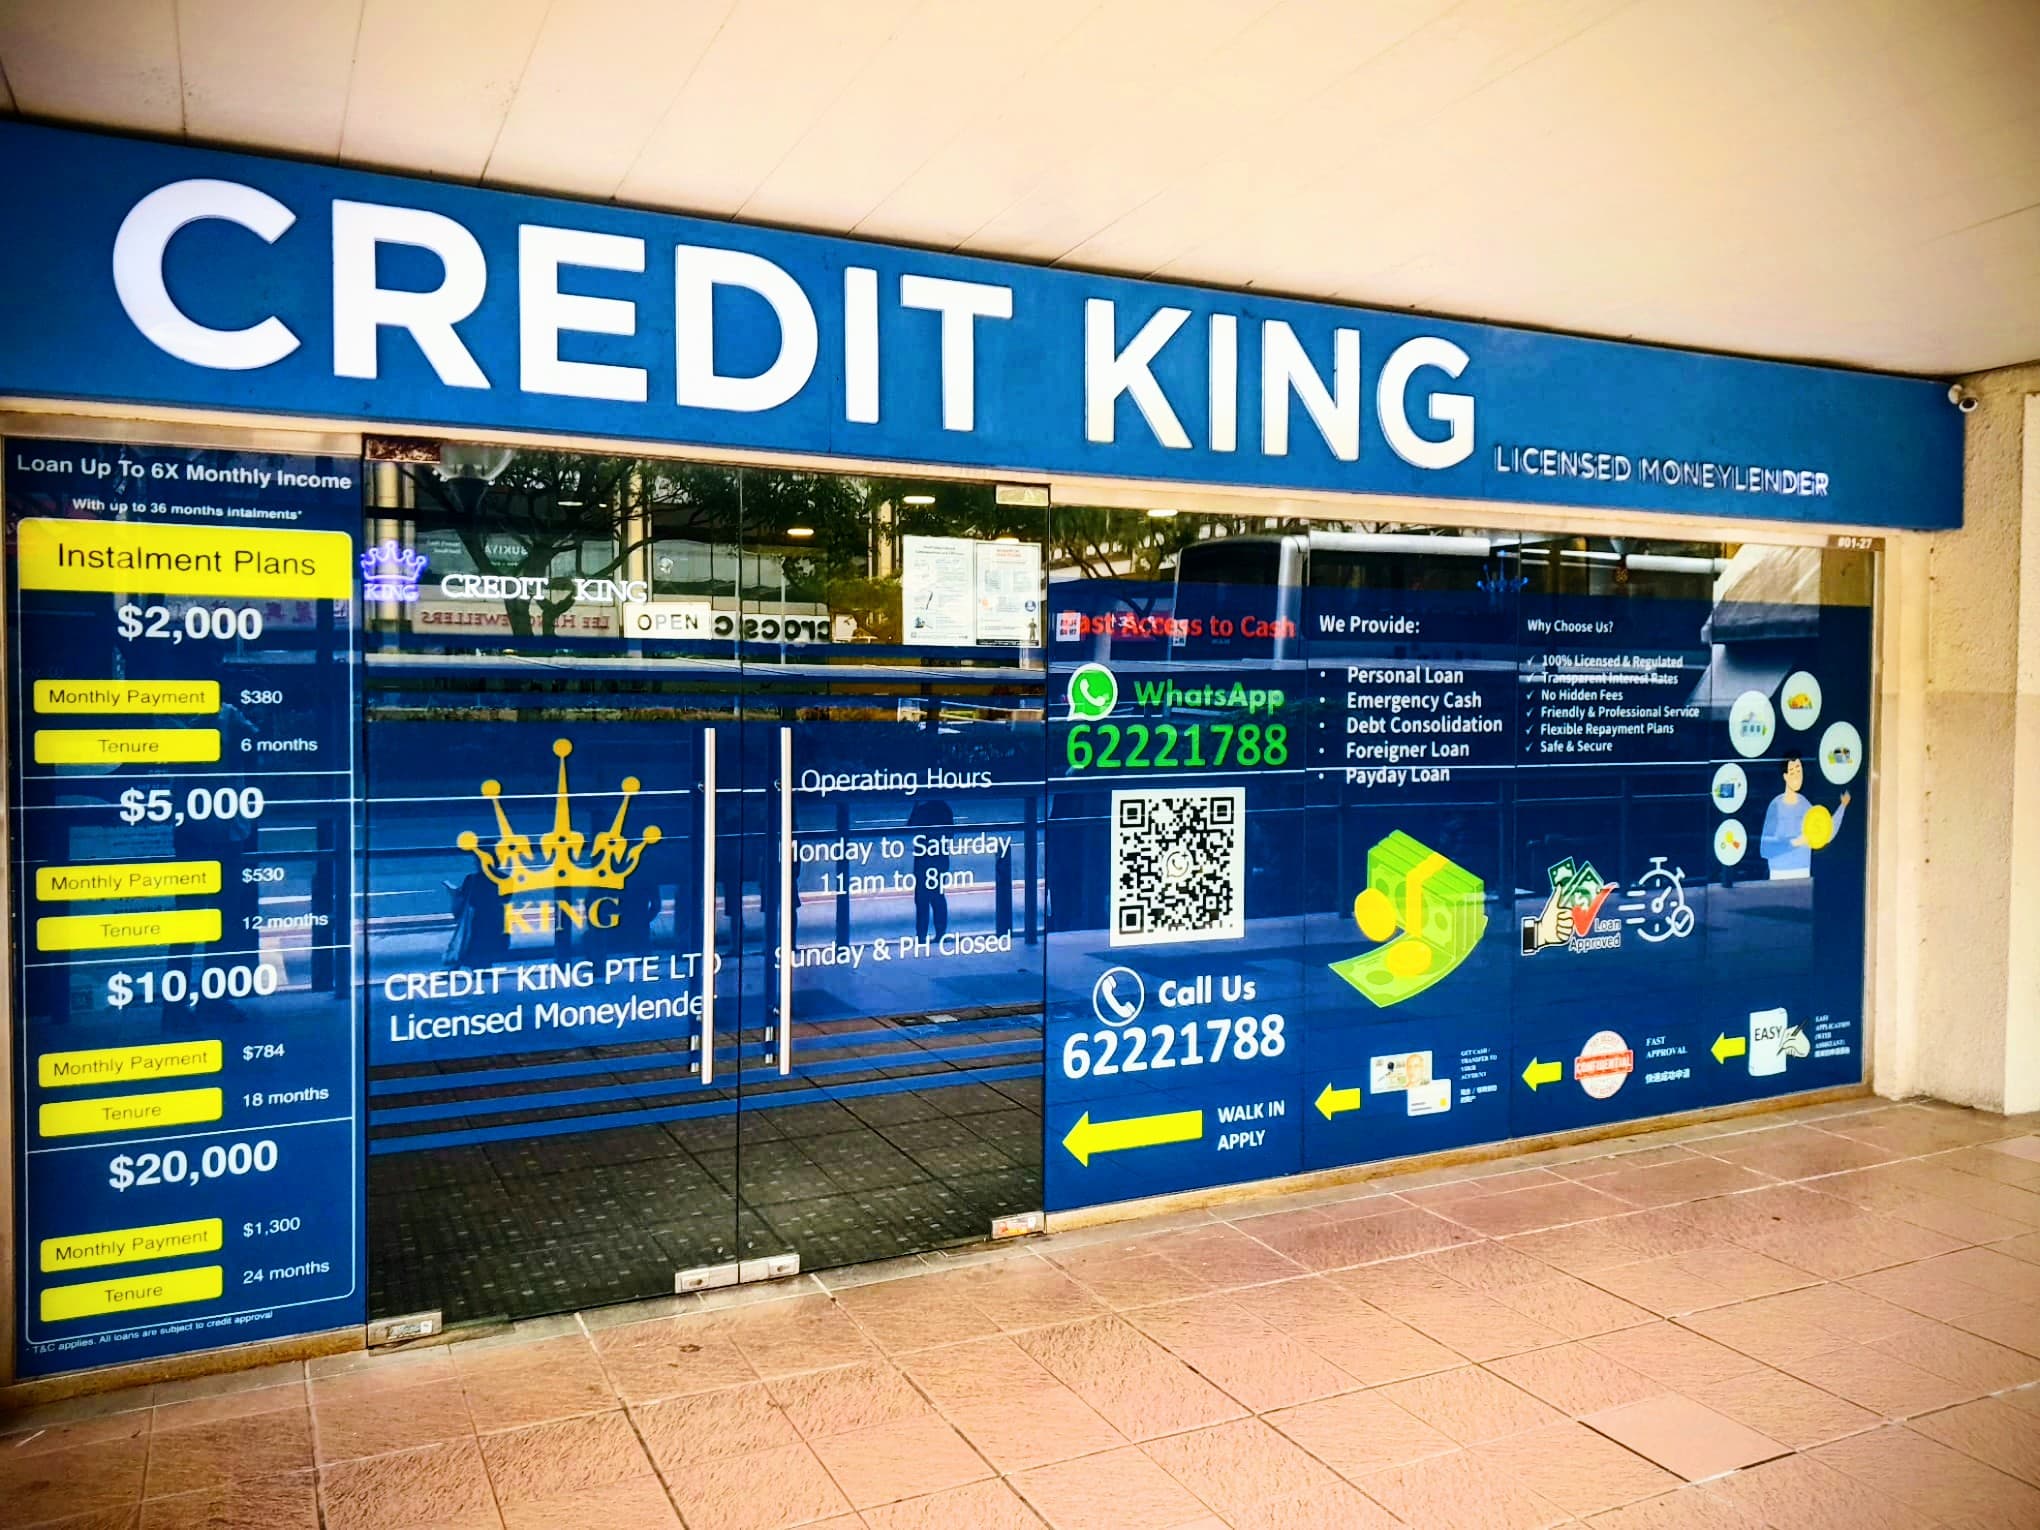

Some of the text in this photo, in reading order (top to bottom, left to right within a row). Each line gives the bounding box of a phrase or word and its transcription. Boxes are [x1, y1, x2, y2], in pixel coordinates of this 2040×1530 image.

[113, 178, 1475, 469] CREDIT KING
[17, 454, 352, 489] Loan Up To 6X Monthly Income
[1495, 445, 1830, 496] LICENSED MONEYLENDER
[73, 498, 105, 511] With
[110, 502, 127, 514] up
[132, 502, 146, 512] to
[150, 503, 167, 513] 36
[171, 505, 223, 516] months
[58, 543, 316, 576] Instalment Plans
[364, 582, 420, 602] KING
[440, 574, 648, 602] CREDIT KING
[117, 603, 263, 644] $2,000
[637, 613, 698, 631] OPEN
[1209, 616, 1233, 636] to
[1240, 615, 1296, 638] Cash
[1319, 615, 1420, 634] We Provide:
[1527, 619, 1614, 634] Why Choose Us?
[1542, 654, 1683, 670] 100% Licensed & Regulated
[1347, 666, 1464, 684] Personal Loan
[1651, 673, 1678, 685] Rates
[49, 689, 205, 708] Monthly Payment
[241, 690, 282, 705] $380
[1134, 679, 1285, 715] WhatsApp
[1347, 691, 1482, 713] Emergency Cash
[1541, 688, 1623, 701] No Hidden Fees
[1541, 705, 1700, 720] Friendly & Professional Service
[1346, 715, 1503, 734] Debt Consolidation
[1540, 722, 1674, 737] Flexible Repayment Plans
[98, 739, 159, 753] Tenure
[241, 738, 318, 752] 6 months
[1067, 723, 1288, 769] 62221788
[1346, 740, 1470, 762] Foreigner Loan
[1540, 740, 1613, 753] Safe & Secure
[801, 768, 992, 796] Operating Hours
[1346, 766, 1450, 788] Payday Loan
[119, 787, 264, 826] $5,000
[881, 839, 904, 857] to
[912, 831, 1011, 858] Saturday
[51, 872, 207, 892] Monthly Payment
[242, 867, 285, 883] $530
[820, 867, 975, 894] 11am to 8pm
[242, 912, 329, 930] 12 months
[503, 896, 620, 935] KING
[1594, 917, 1622, 932] Loan
[100, 922, 160, 938] Tenure
[873, 939, 891, 961] &
[900, 935, 930, 959] PH
[938, 928, 1012, 956] Closed
[1569, 934, 1622, 953] Approved
[107, 964, 278, 1010] $10,000
[384, 968, 510, 1001] CREDIT
[517, 961, 593, 991] KING
[605, 955, 659, 985] PTE
[1159, 975, 1256, 1007] Call Us
[390, 990, 718, 1042] Licensed Moneylende
[1646, 1036, 1666, 1047] FAST
[1754, 1026, 1782, 1041] EASY
[242, 1043, 285, 1061] $784
[1063, 1014, 1286, 1080] 62221788
[1646, 1046, 1688, 1059] APPROVAL
[54, 1051, 208, 1077] Monthly Payment
[243, 1087, 329, 1108] 18 months
[102, 1104, 161, 1122] Tenure
[1217, 1100, 1285, 1124] WALK IN
[1217, 1130, 1266, 1151] APPLY
[109, 1140, 278, 1191] $20,000
[243, 1216, 301, 1238] $1,300
[55, 1229, 208, 1262] Monthly Payment
[243, 1261, 330, 1285] 24 months
[104, 1284, 163, 1303] Tenure
[114, 1331, 139, 1341] loans
[142, 1329, 157, 1338] are
[159, 1323, 193, 1335] subject
[195, 1321, 204, 1330] to
[206, 1316, 232, 1328] credit
[234, 1310, 273, 1325] approval
